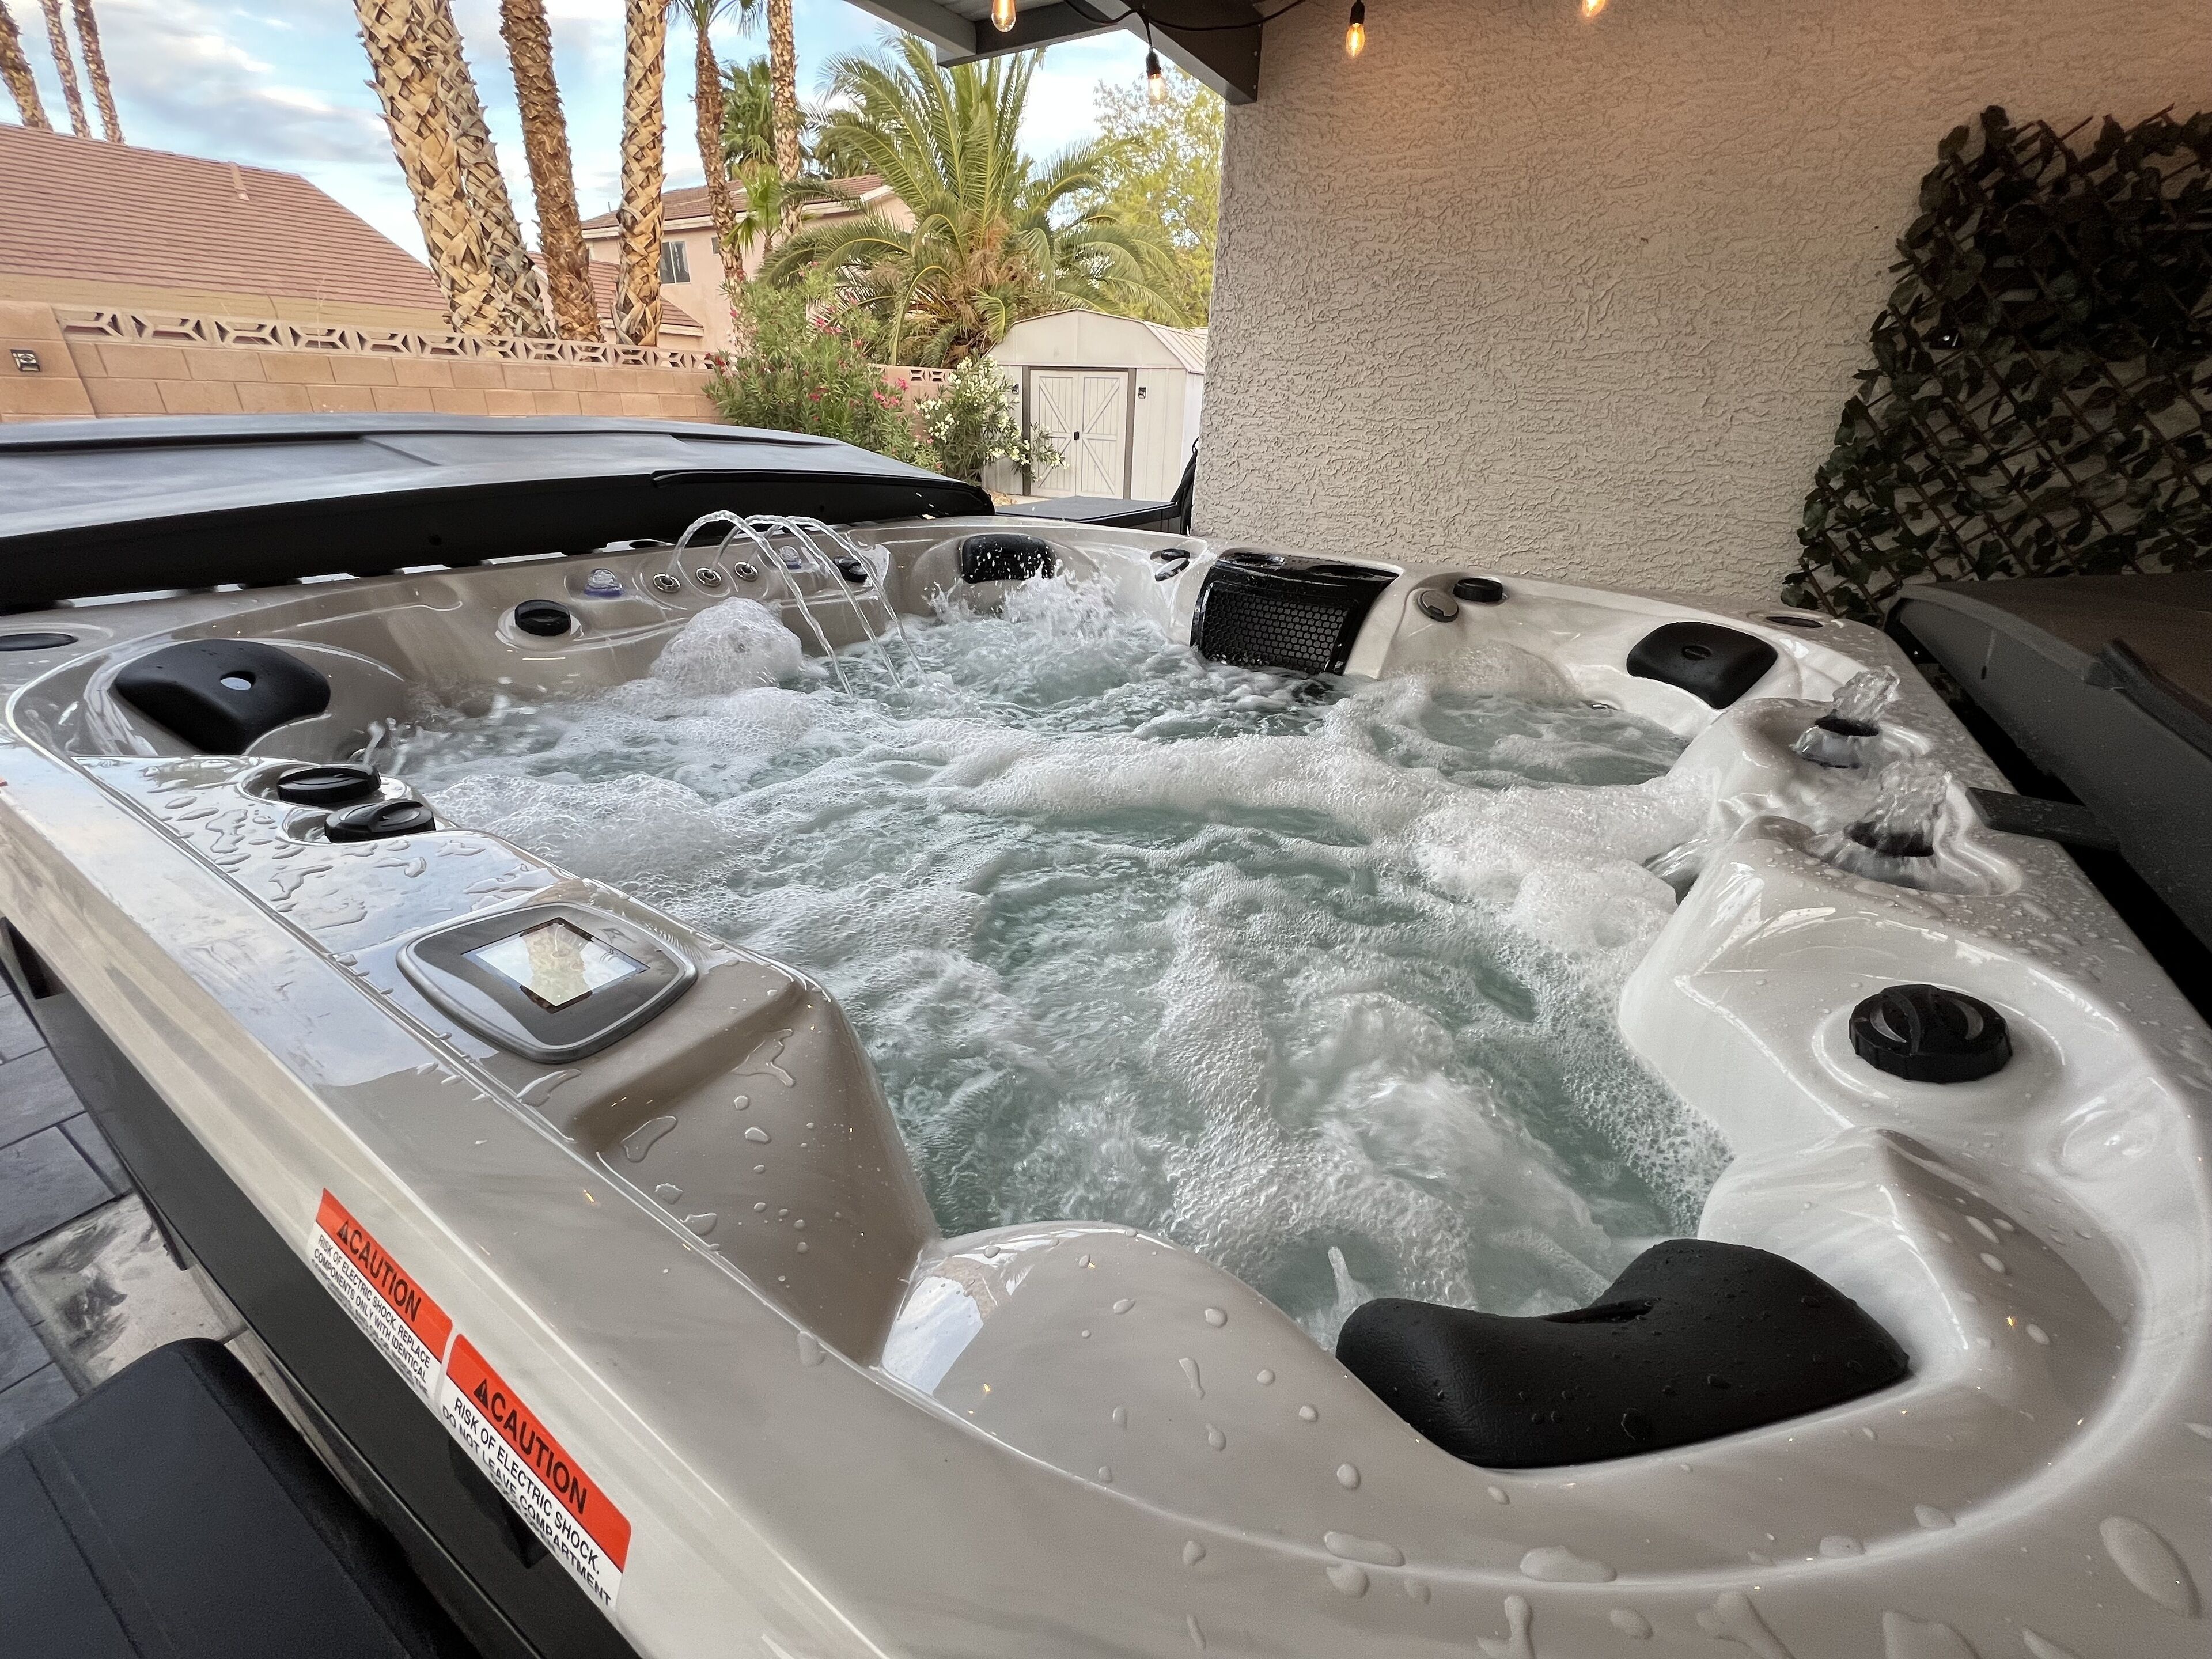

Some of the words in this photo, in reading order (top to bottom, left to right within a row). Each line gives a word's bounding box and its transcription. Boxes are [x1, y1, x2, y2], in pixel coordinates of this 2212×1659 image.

[314, 1248, 355, 1300] COMPONENTS
[355, 1296, 374, 1320] ONLY
[374, 1315, 391, 1341] WITH
[391, 1335, 427, 1383] IDENTICAL
[318, 1234, 334, 1257] RISK
[332, 1251, 343, 1266] OF
[342, 1261, 372, 1301] ELECTRIC
[398, 1324, 431, 1369] REPLACE
[350, 1229, 421, 1322] CAUTION
[442, 1404, 456, 1428] DO
[459, 1423, 480, 1454] NOT
[482, 1450, 517, 1495] LEAVE
[520, 1494, 611, 1606] COMPARTMENT
[454, 1397, 479, 1434] RISK
[480, 1427, 496, 1449] OF
[497, 1445, 552, 1517] ELECTRIC
[554, 1511, 599, 1575] SHOCK.
[491, 1392, 587, 1515] CAUTION
